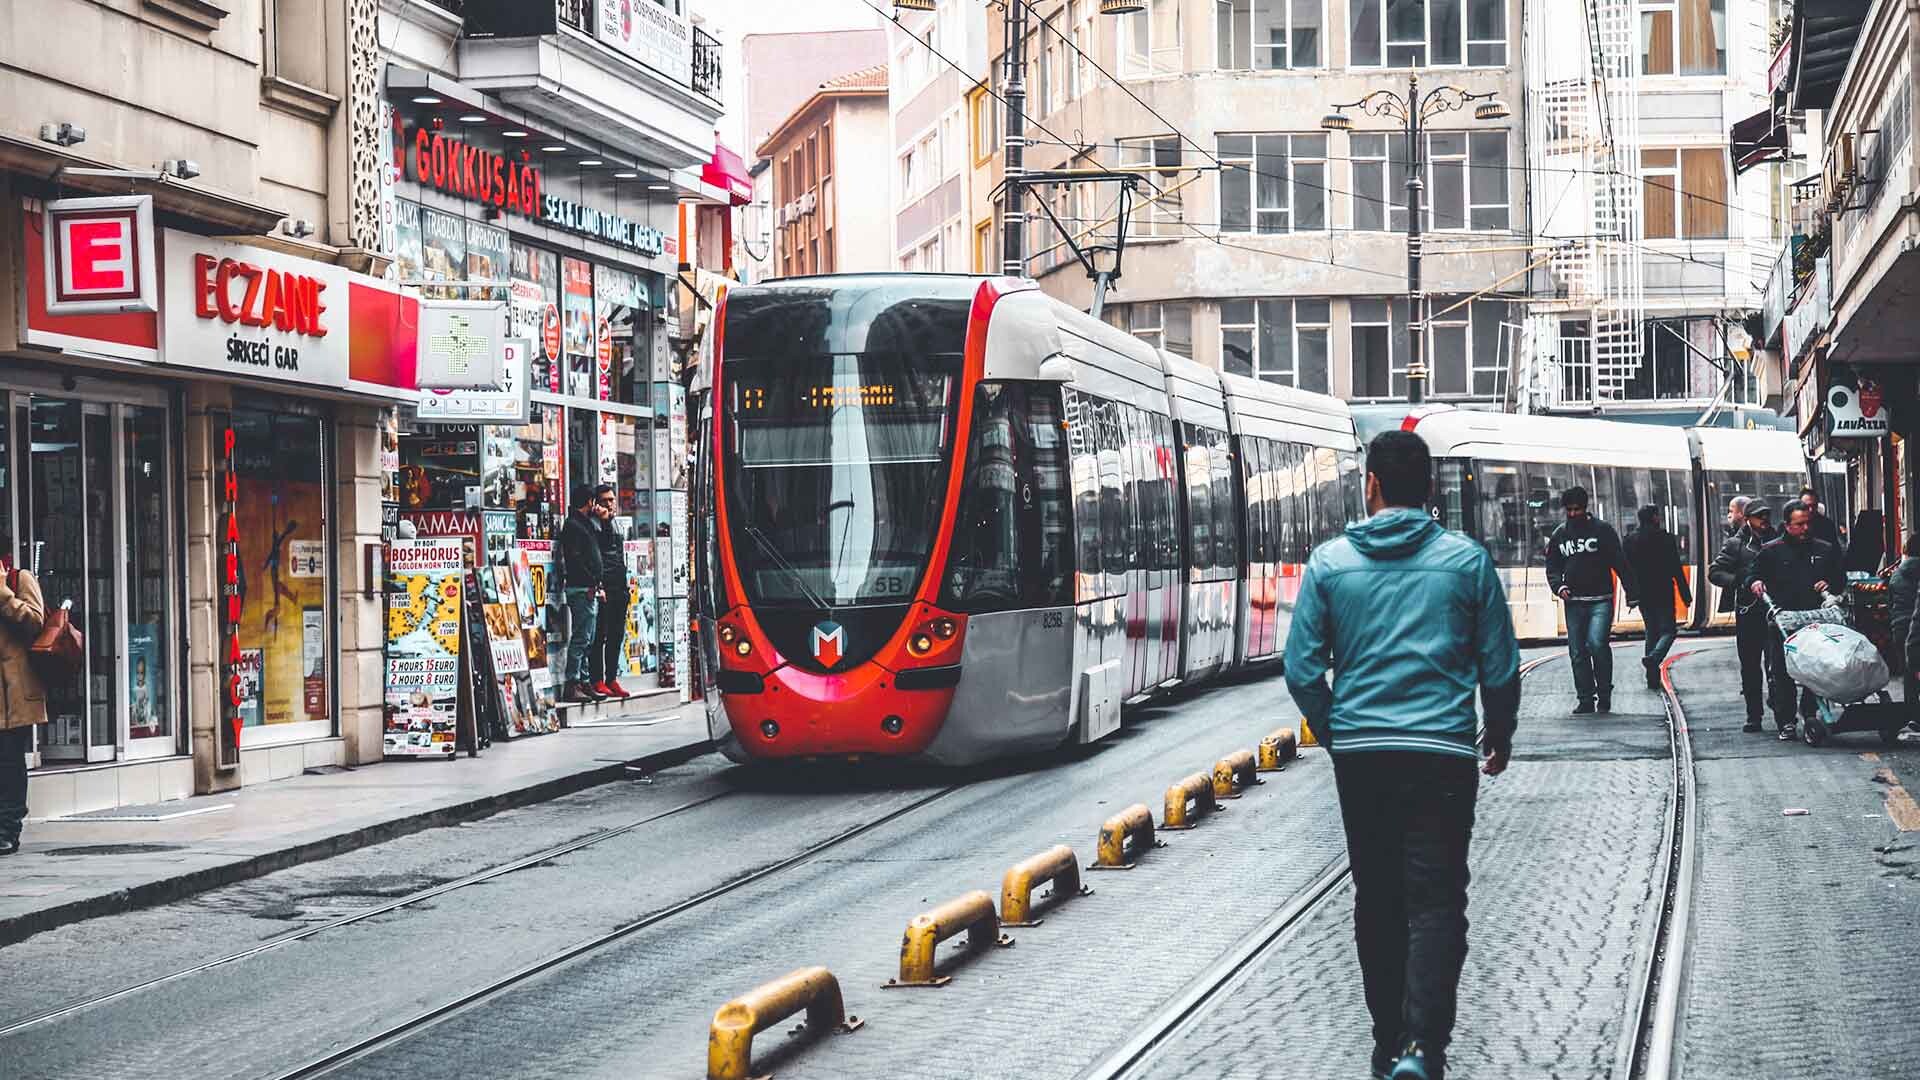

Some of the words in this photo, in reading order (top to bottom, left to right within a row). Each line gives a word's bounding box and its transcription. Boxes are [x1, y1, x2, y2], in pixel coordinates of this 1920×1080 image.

[426, 210, 463, 242] TRABZON
[545, 194, 566, 221] SEA
[566, 205, 575, 228] &
[575, 206, 600, 236] LAND
[600, 213, 633, 246] TRAVEL
[69, 221, 125, 290] E
[195, 252, 329, 337] ECZANE
[274, 345, 299, 372] GAR
[1837, 416, 1886, 431] LAVAZZA
[400, 513, 479, 534] AMAM
[391, 547, 460, 562] BOSPHORUS
[398, 562, 423, 570] GOLDEN
[443, 561, 459, 569] TOUR
[225, 428, 243, 748] PHARMACY
[391, 660, 397, 672] 5
[399, 661, 424, 672] HOURS
[426, 659, 434, 671] 15
[434, 660, 455, 671] EURO
[391, 674, 397, 685] 2
[398, 674, 424, 685] HOURS
[426, 673, 433, 684] 8
[434, 674, 455, 684] EURO
